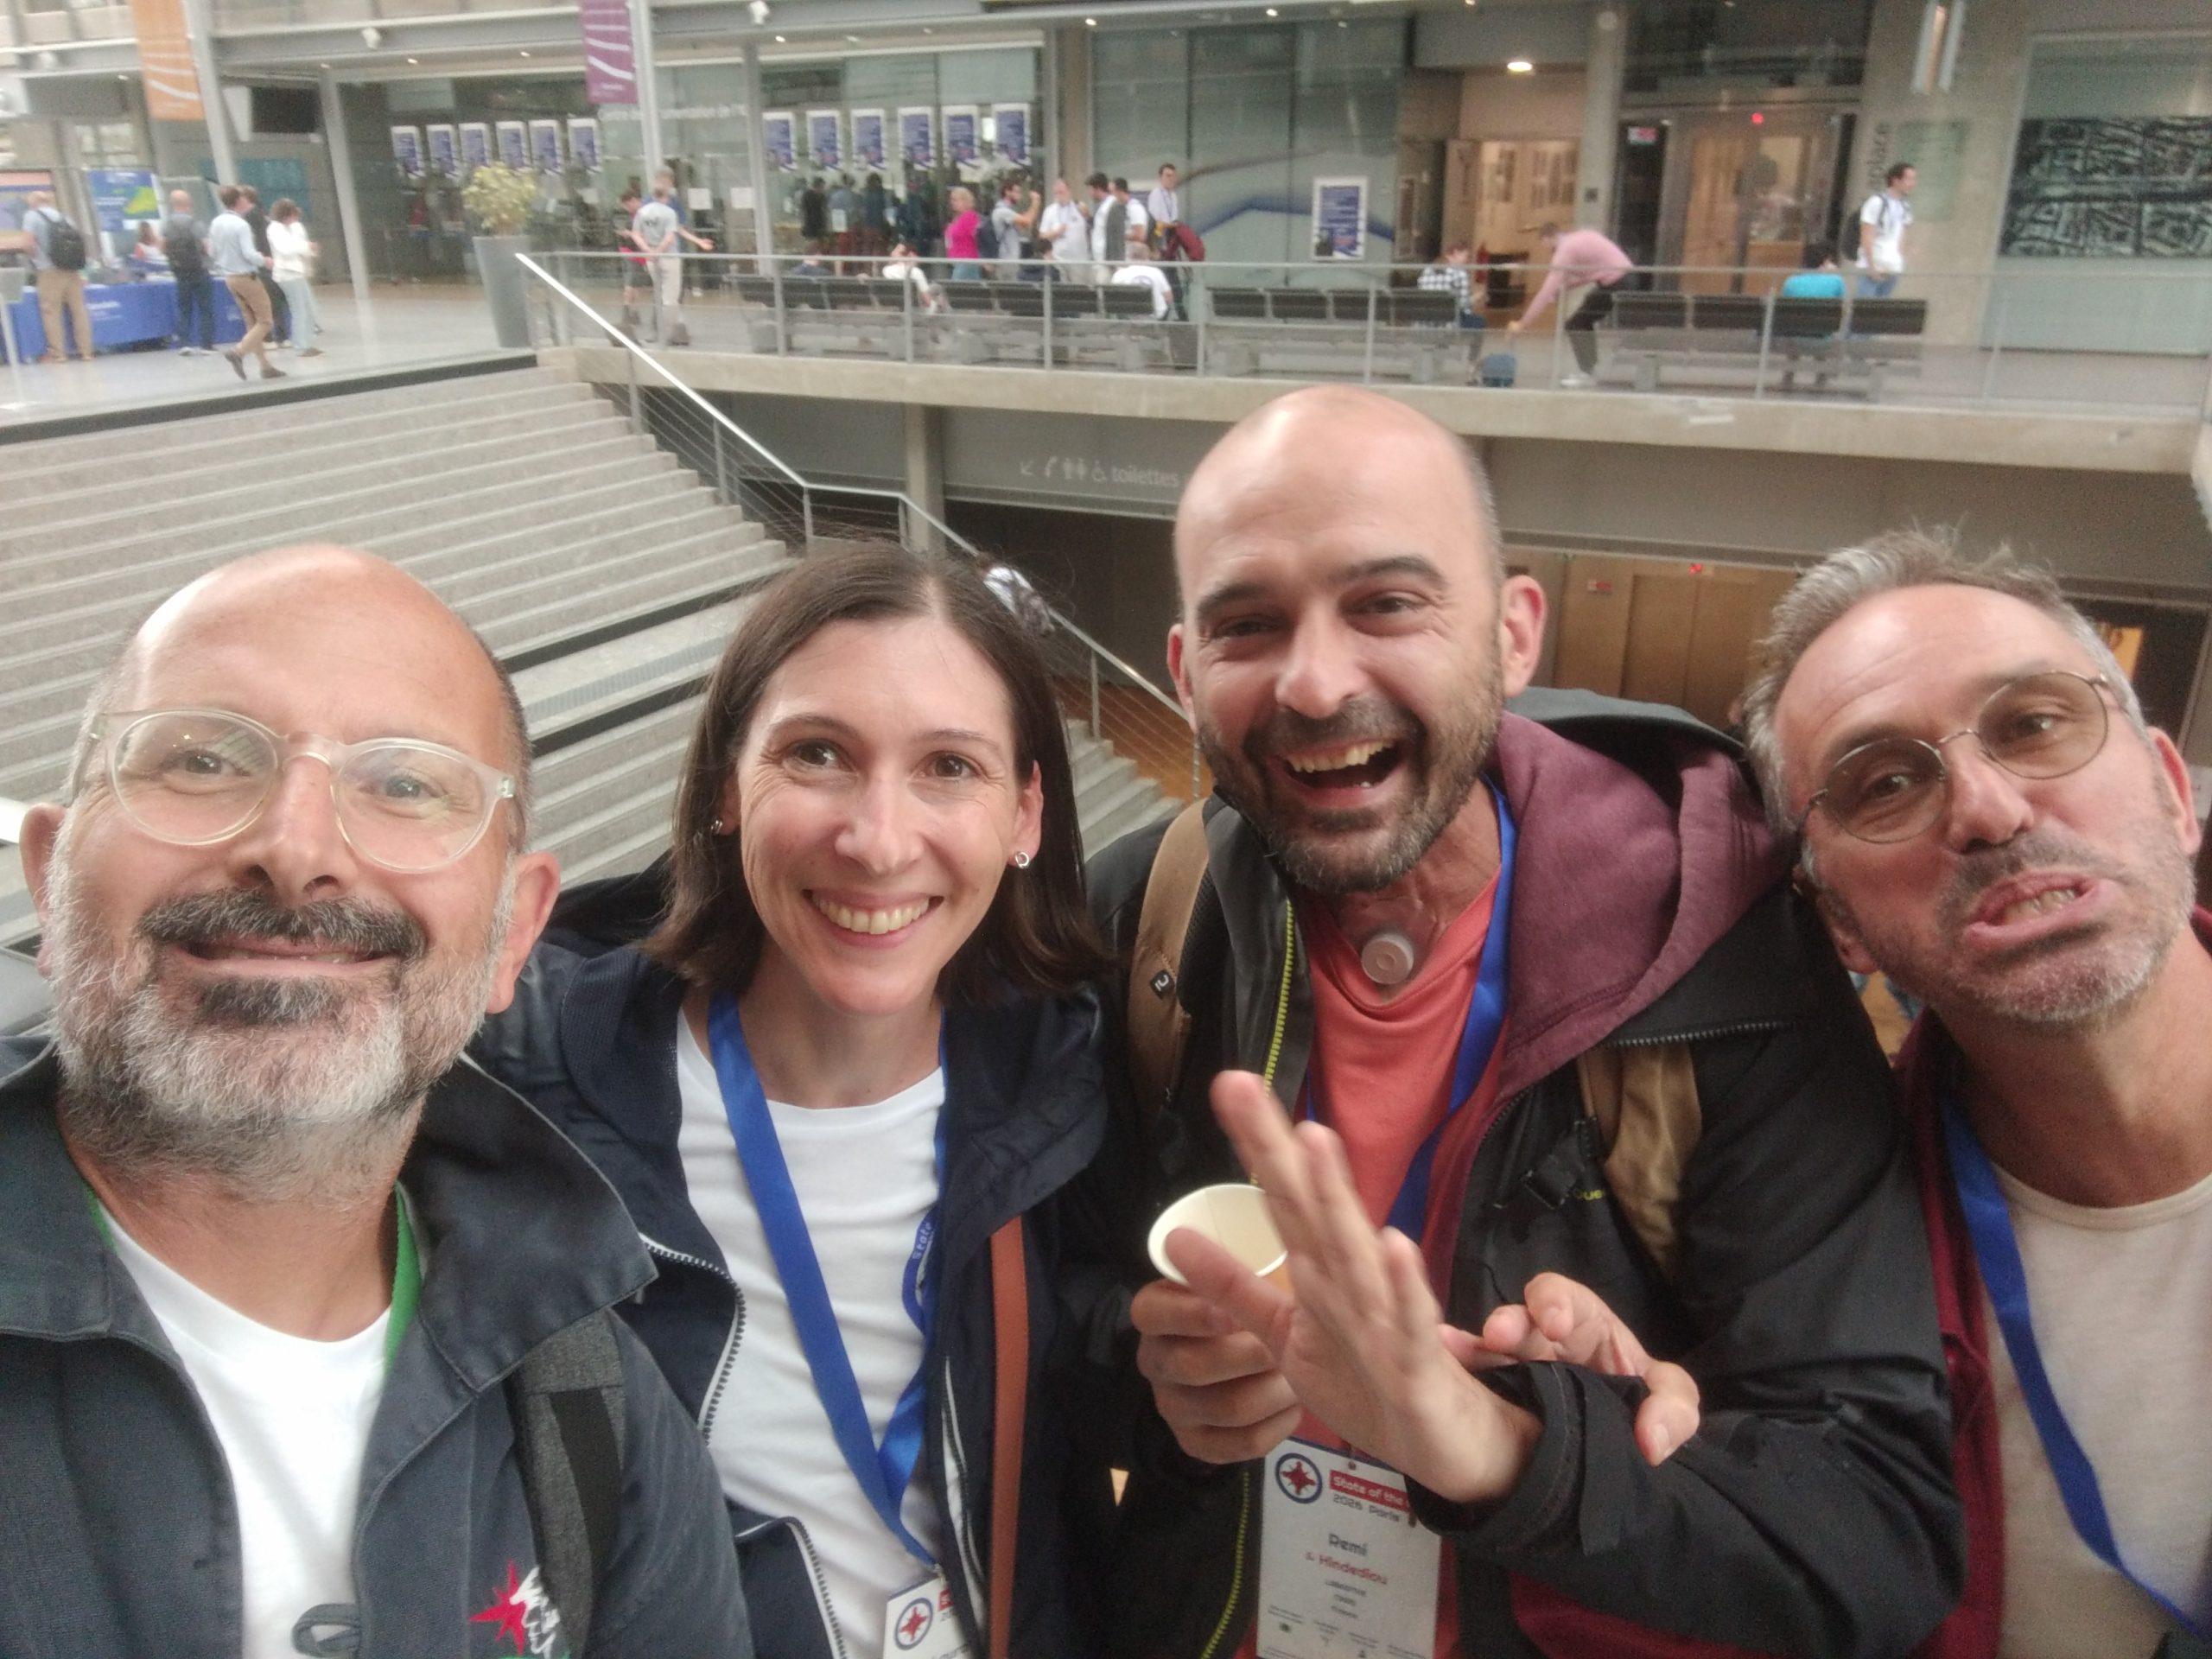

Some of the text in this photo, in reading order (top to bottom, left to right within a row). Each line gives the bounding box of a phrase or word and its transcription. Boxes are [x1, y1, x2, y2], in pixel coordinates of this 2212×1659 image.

[1112, 464, 1179, 487] toilettes
[912, 1222, 931, 1260] State
[1333, 1476, 1365, 1495] State
[1368, 1488, 1382, 1498] of
